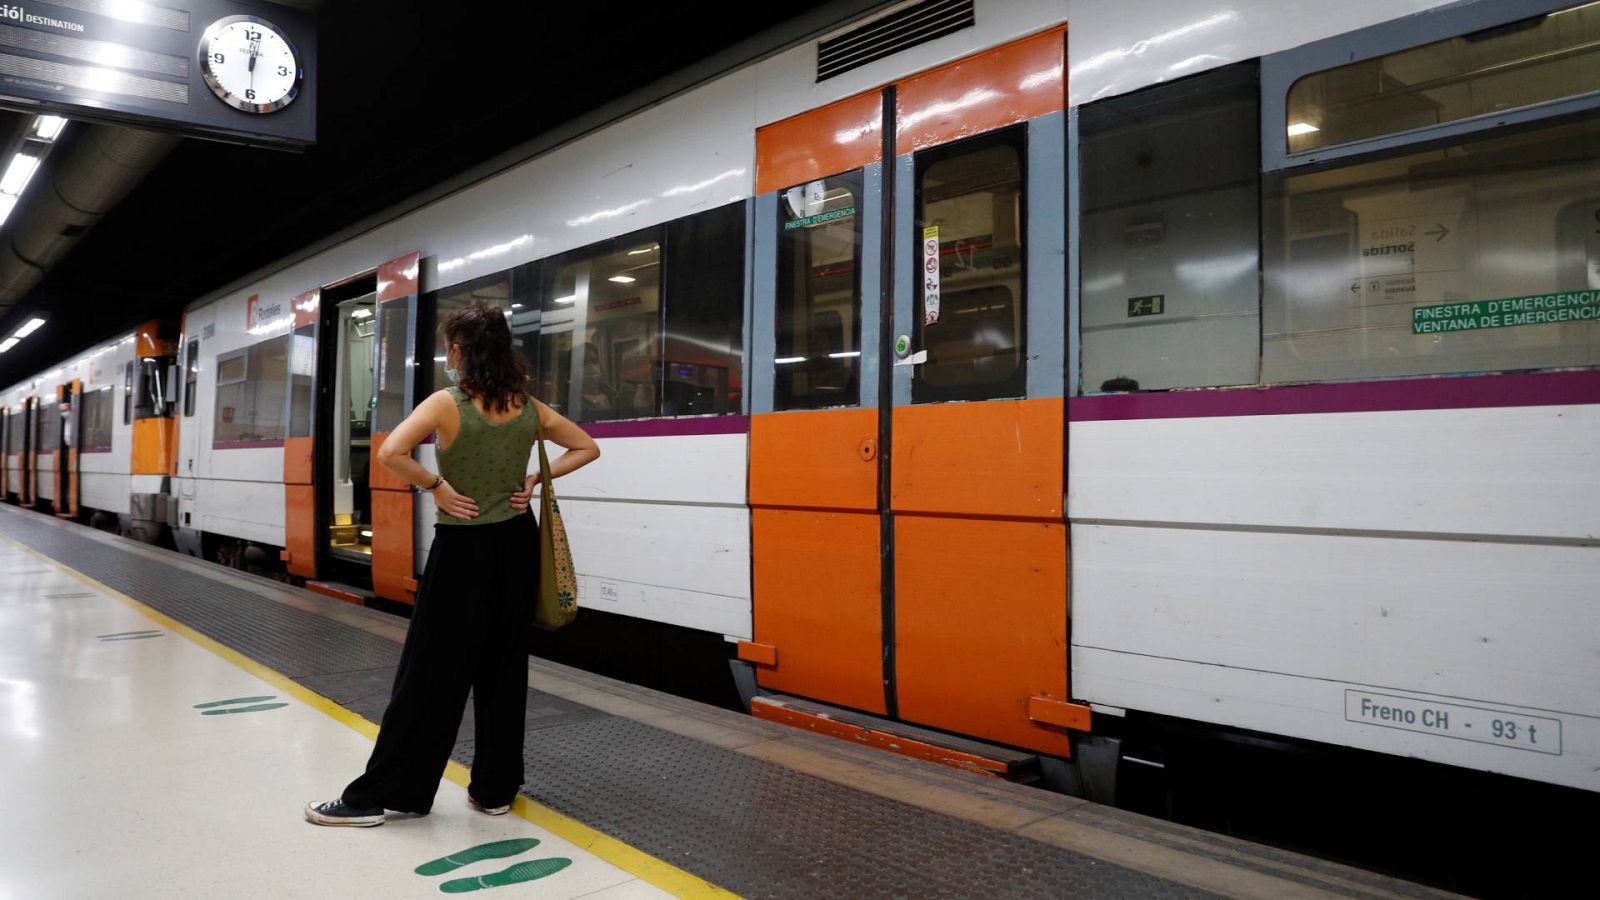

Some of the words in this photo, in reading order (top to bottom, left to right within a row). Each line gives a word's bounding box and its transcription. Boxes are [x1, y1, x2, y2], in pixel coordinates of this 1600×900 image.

[26, 14, 84, 32] DESTINATION
[244, 29, 262, 42] 12
[214, 53, 225, 64] 9
[277, 66, 288, 77] 3
[245, 89, 256, 100] 6
[785, 219, 811, 230] FINESTRA
[1414, 303, 1481, 320] FINESTRA
[1414, 317, 1478, 333] VENTANA
[1480, 315, 1500, 328] DE
[1361, 698, 1416, 724] Freno
[1422, 709, 1449, 730] CH
[1492, 719, 1517, 740] 93
[1528, 724, 1537, 744] t
